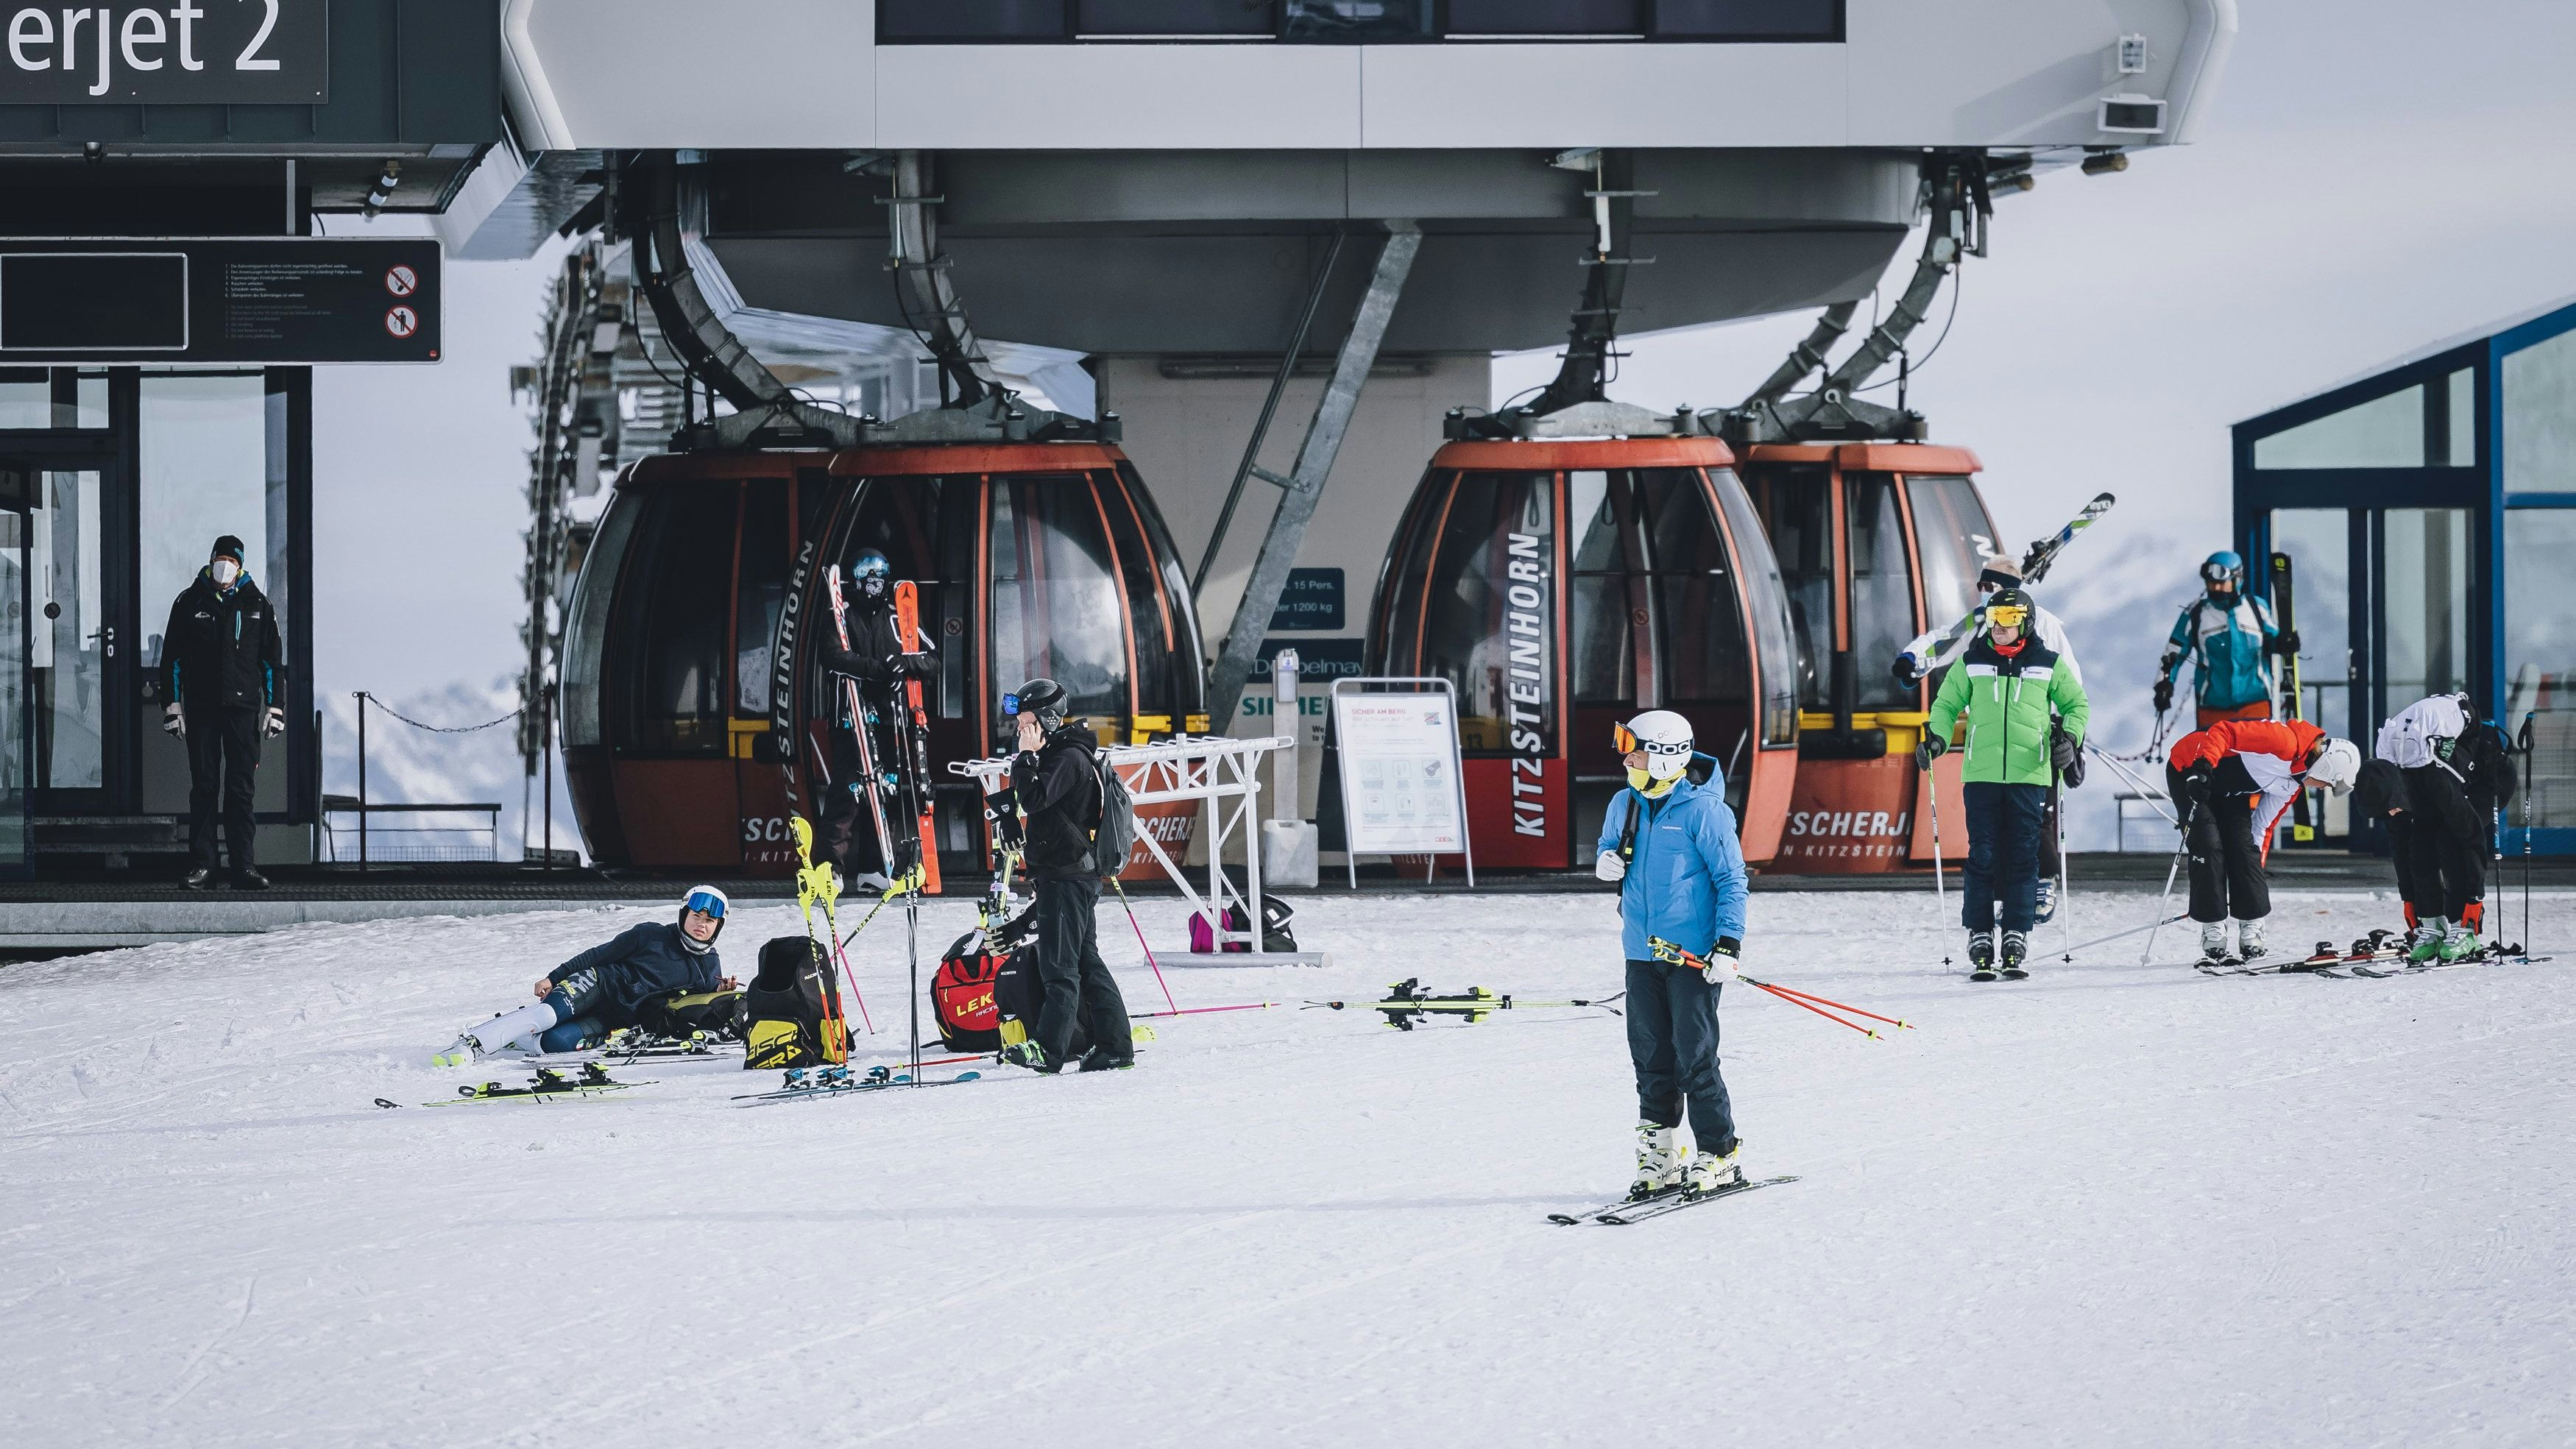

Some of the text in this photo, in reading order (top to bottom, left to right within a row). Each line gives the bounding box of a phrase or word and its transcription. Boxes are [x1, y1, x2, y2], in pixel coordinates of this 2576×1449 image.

[8, 0, 280, 96] erjet 2
[1293, 603, 1317, 612] 1200
[1320, 603, 1333, 613] kg
[1294, 581, 1306, 589] 15
[776, 540, 813, 818] ITZSTEINHORN
[1509, 533, 1545, 837] KITZSTEINHORN
[1786, 811, 1911, 837] SCHERJ
